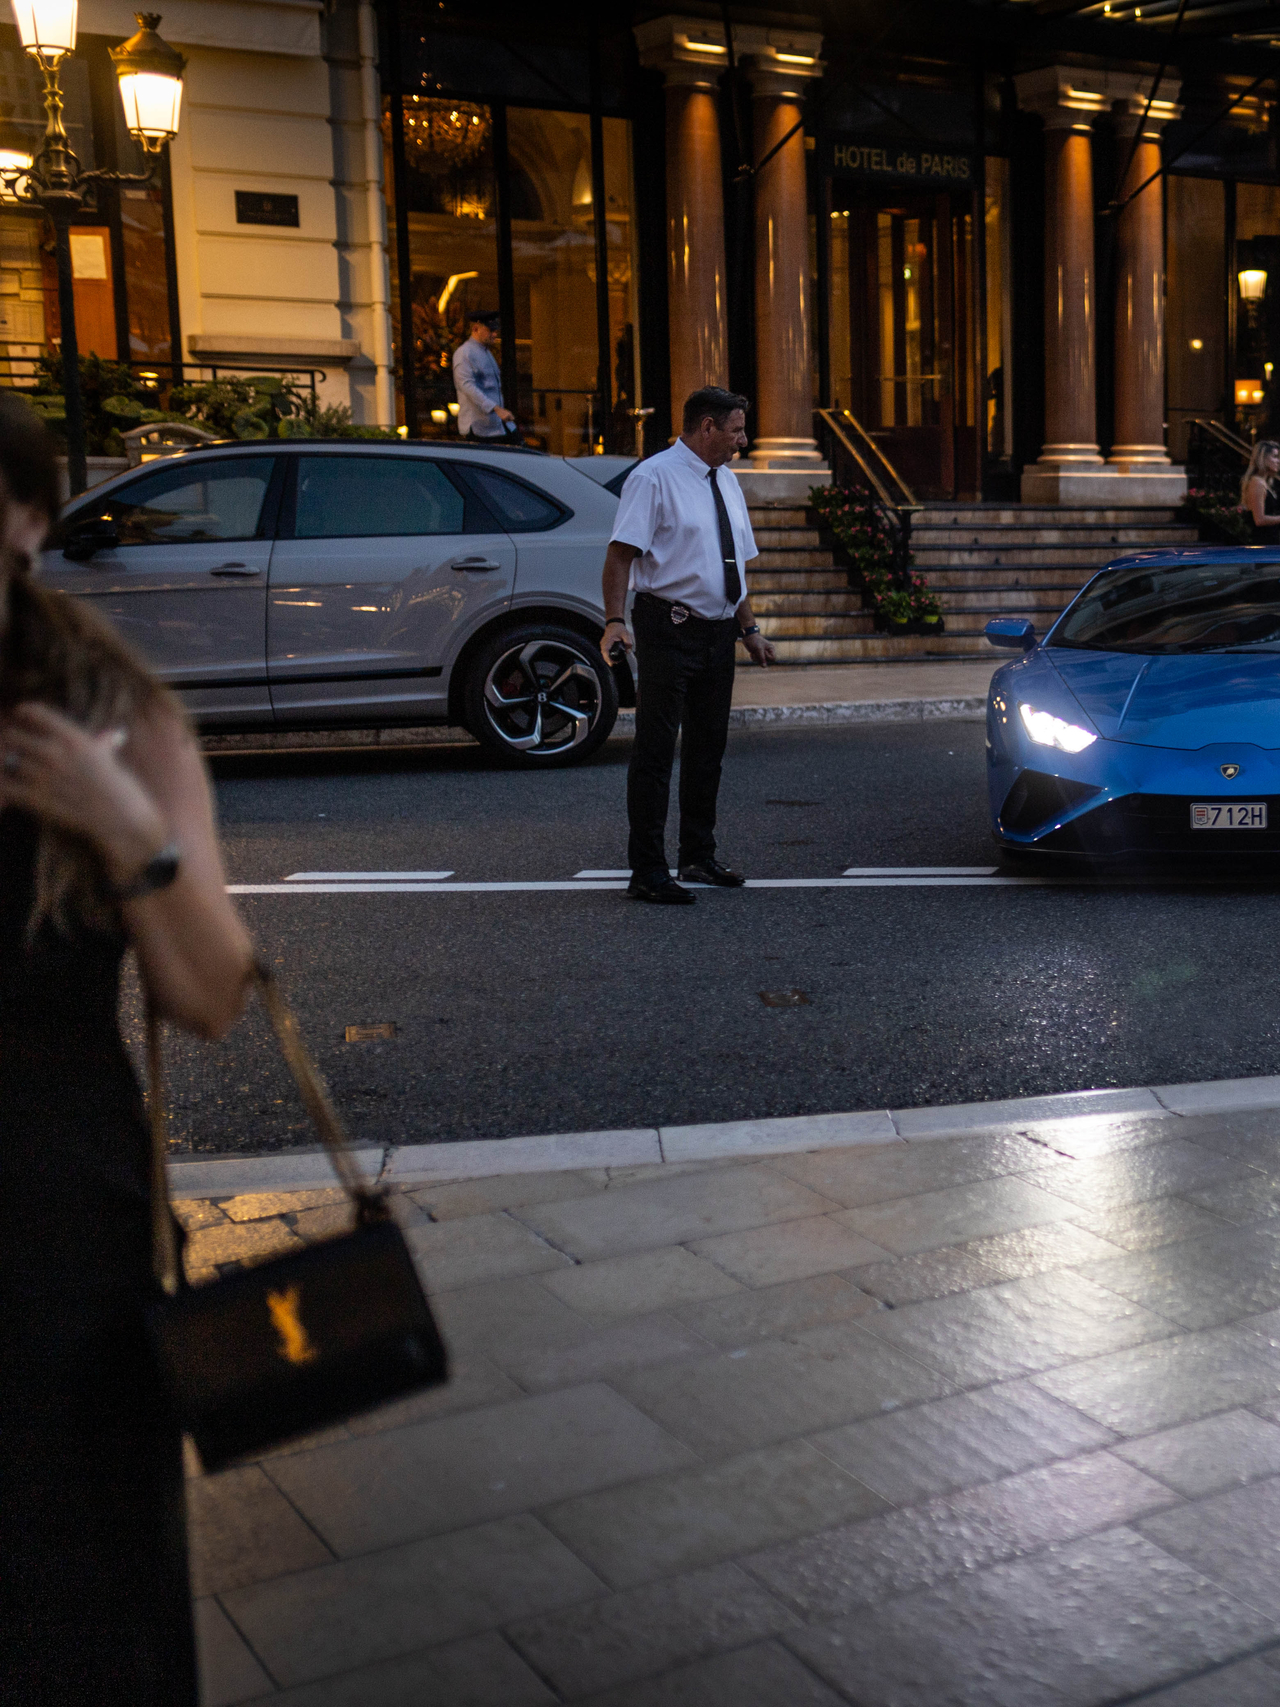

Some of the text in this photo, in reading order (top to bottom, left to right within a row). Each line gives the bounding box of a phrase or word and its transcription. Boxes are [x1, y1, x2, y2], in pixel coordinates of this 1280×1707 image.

[834, 144, 970, 178] HOTEL de PARIS
[1210, 807, 1262, 826] 712H
